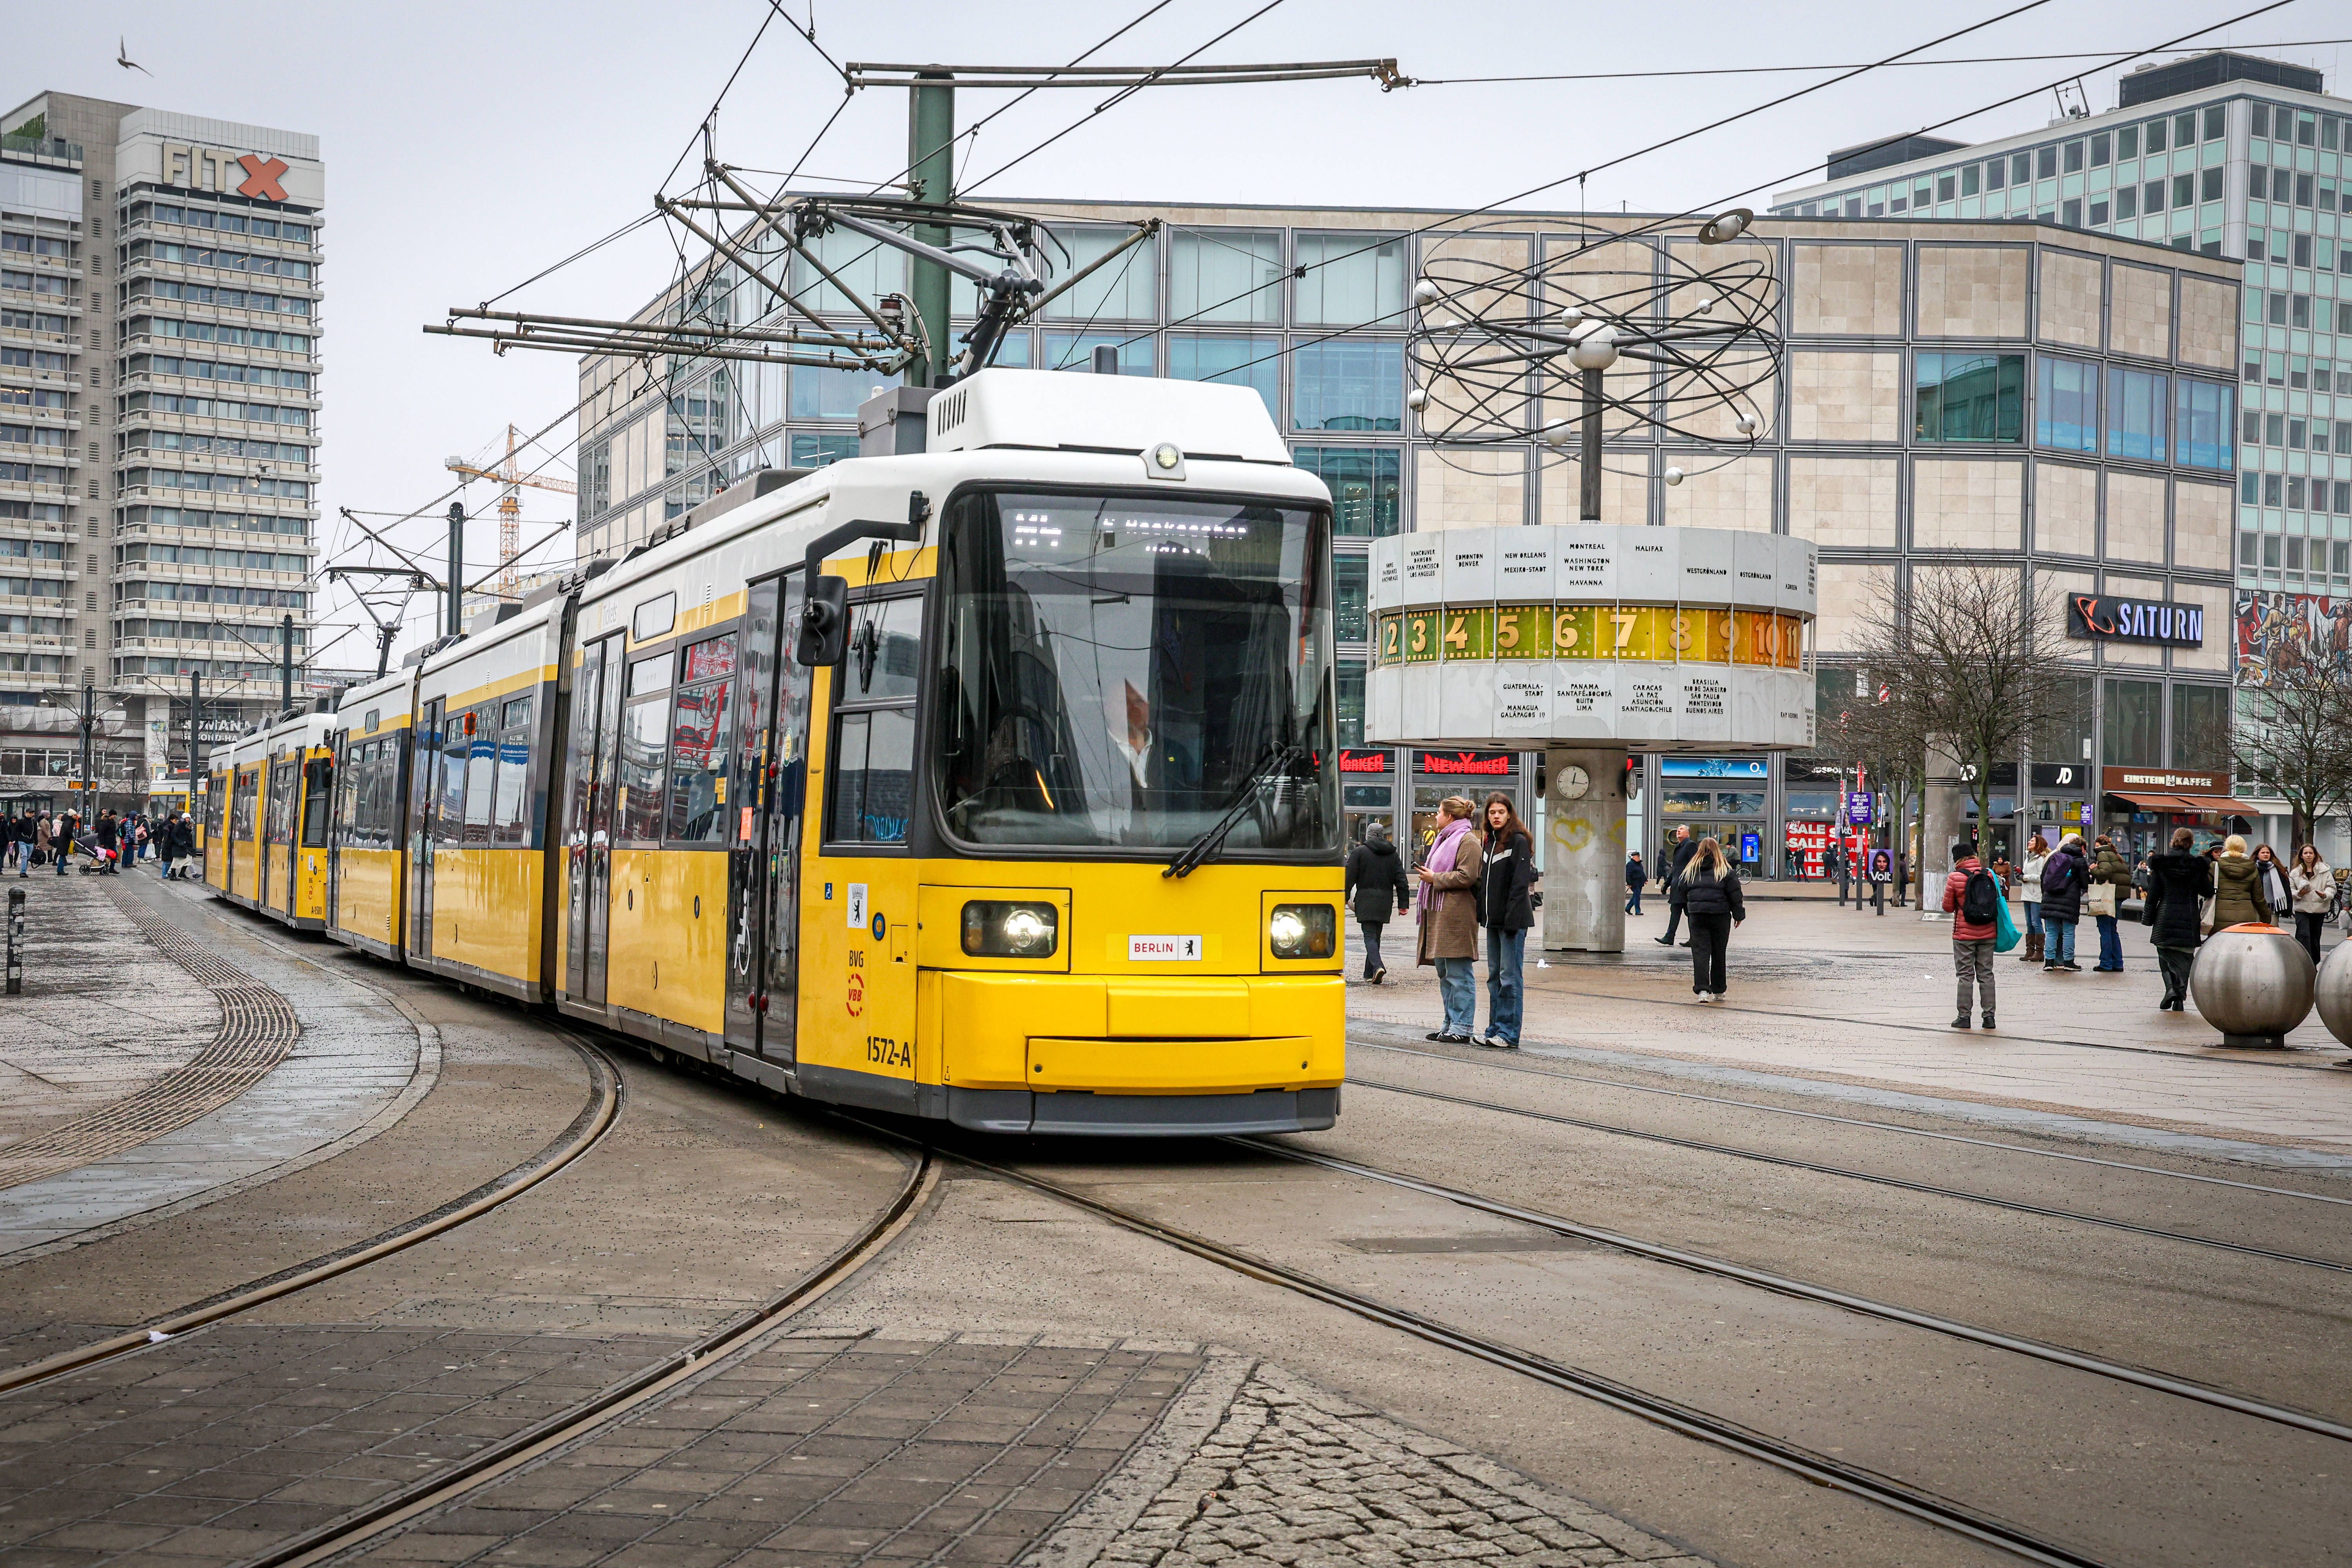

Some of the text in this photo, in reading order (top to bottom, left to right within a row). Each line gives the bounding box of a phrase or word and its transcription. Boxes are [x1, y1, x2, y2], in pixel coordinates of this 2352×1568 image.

[163, 142, 290, 201] FITX
[1740, 572, 1771, 580] OSTGRÖNLAND
[603, 603, 617, 626] Tickets
[2119, 603, 2202, 642] SATURN
[1388, 623, 1398, 655] 2
[1412, 619, 1426, 652] 3
[1445, 617, 1468, 650] 4
[1498, 615, 1519, 648] 5
[1555, 614, 1578, 648] 6
[1610, 615, 1637, 647] 7
[1669, 617, 1692, 650] 8
[1719, 619, 1740, 652] 9
[1755, 622, 1780, 655] 10
[1786, 626, 1797, 658] 11
[2056, 768, 2072, 784] JD
[2124, 775, 2212, 786] EINSTEIN KAFFEE
[1789, 824, 1826, 835] SALE
[1841, 826, 1851, 835] Volt
[1789, 837, 1826, 849] SALE
[1870, 871, 1891, 881] Volt
[311, 906, 322, 915] A-1580
[1134, 943, 1173, 953] BERLIN
[849, 950, 864, 968] BVG
[848, 988, 862, 1002] VBB
[867, 1035, 911, 1068] 1572-A
